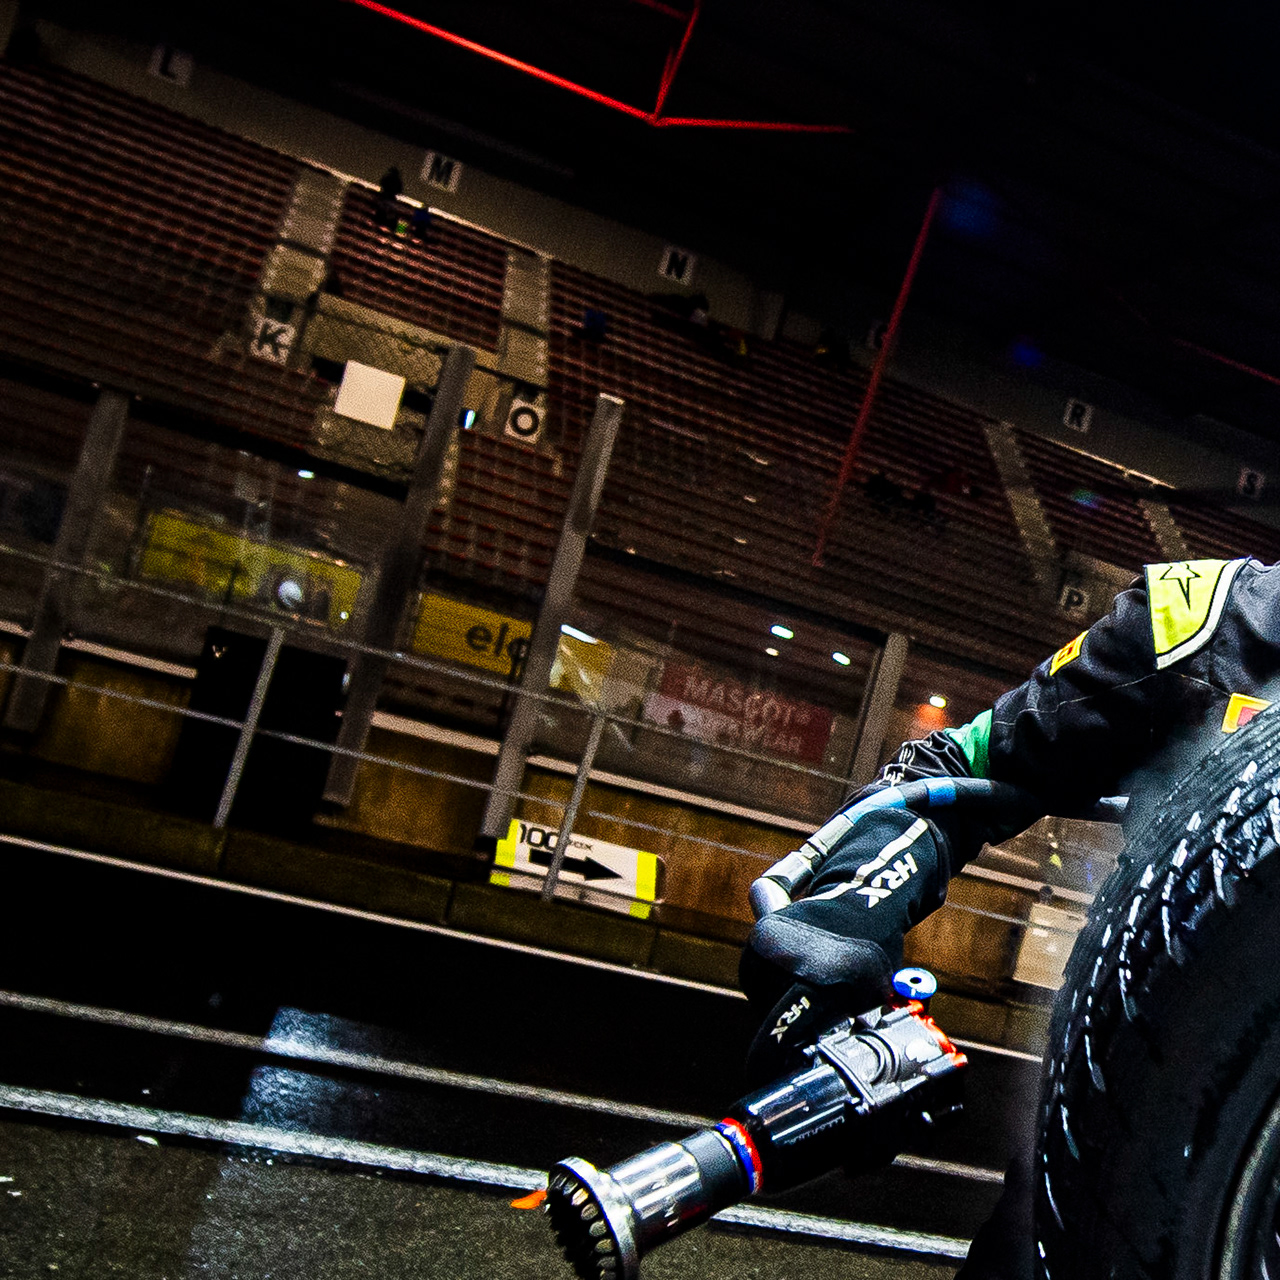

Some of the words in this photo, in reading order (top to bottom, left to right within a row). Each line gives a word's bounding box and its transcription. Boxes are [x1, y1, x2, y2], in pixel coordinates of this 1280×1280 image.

[429, 154, 454, 187] M
[665, 251, 688, 279] N
[256, 323, 288, 357] K
[510, 405, 540, 436] O
[1070, 403, 1086, 428] R
[1242, 471, 1257, 496] S
[1064, 588, 1084, 612] P
[856, 852, 918, 909] HRX
[769, 995, 812, 1044] HRX
